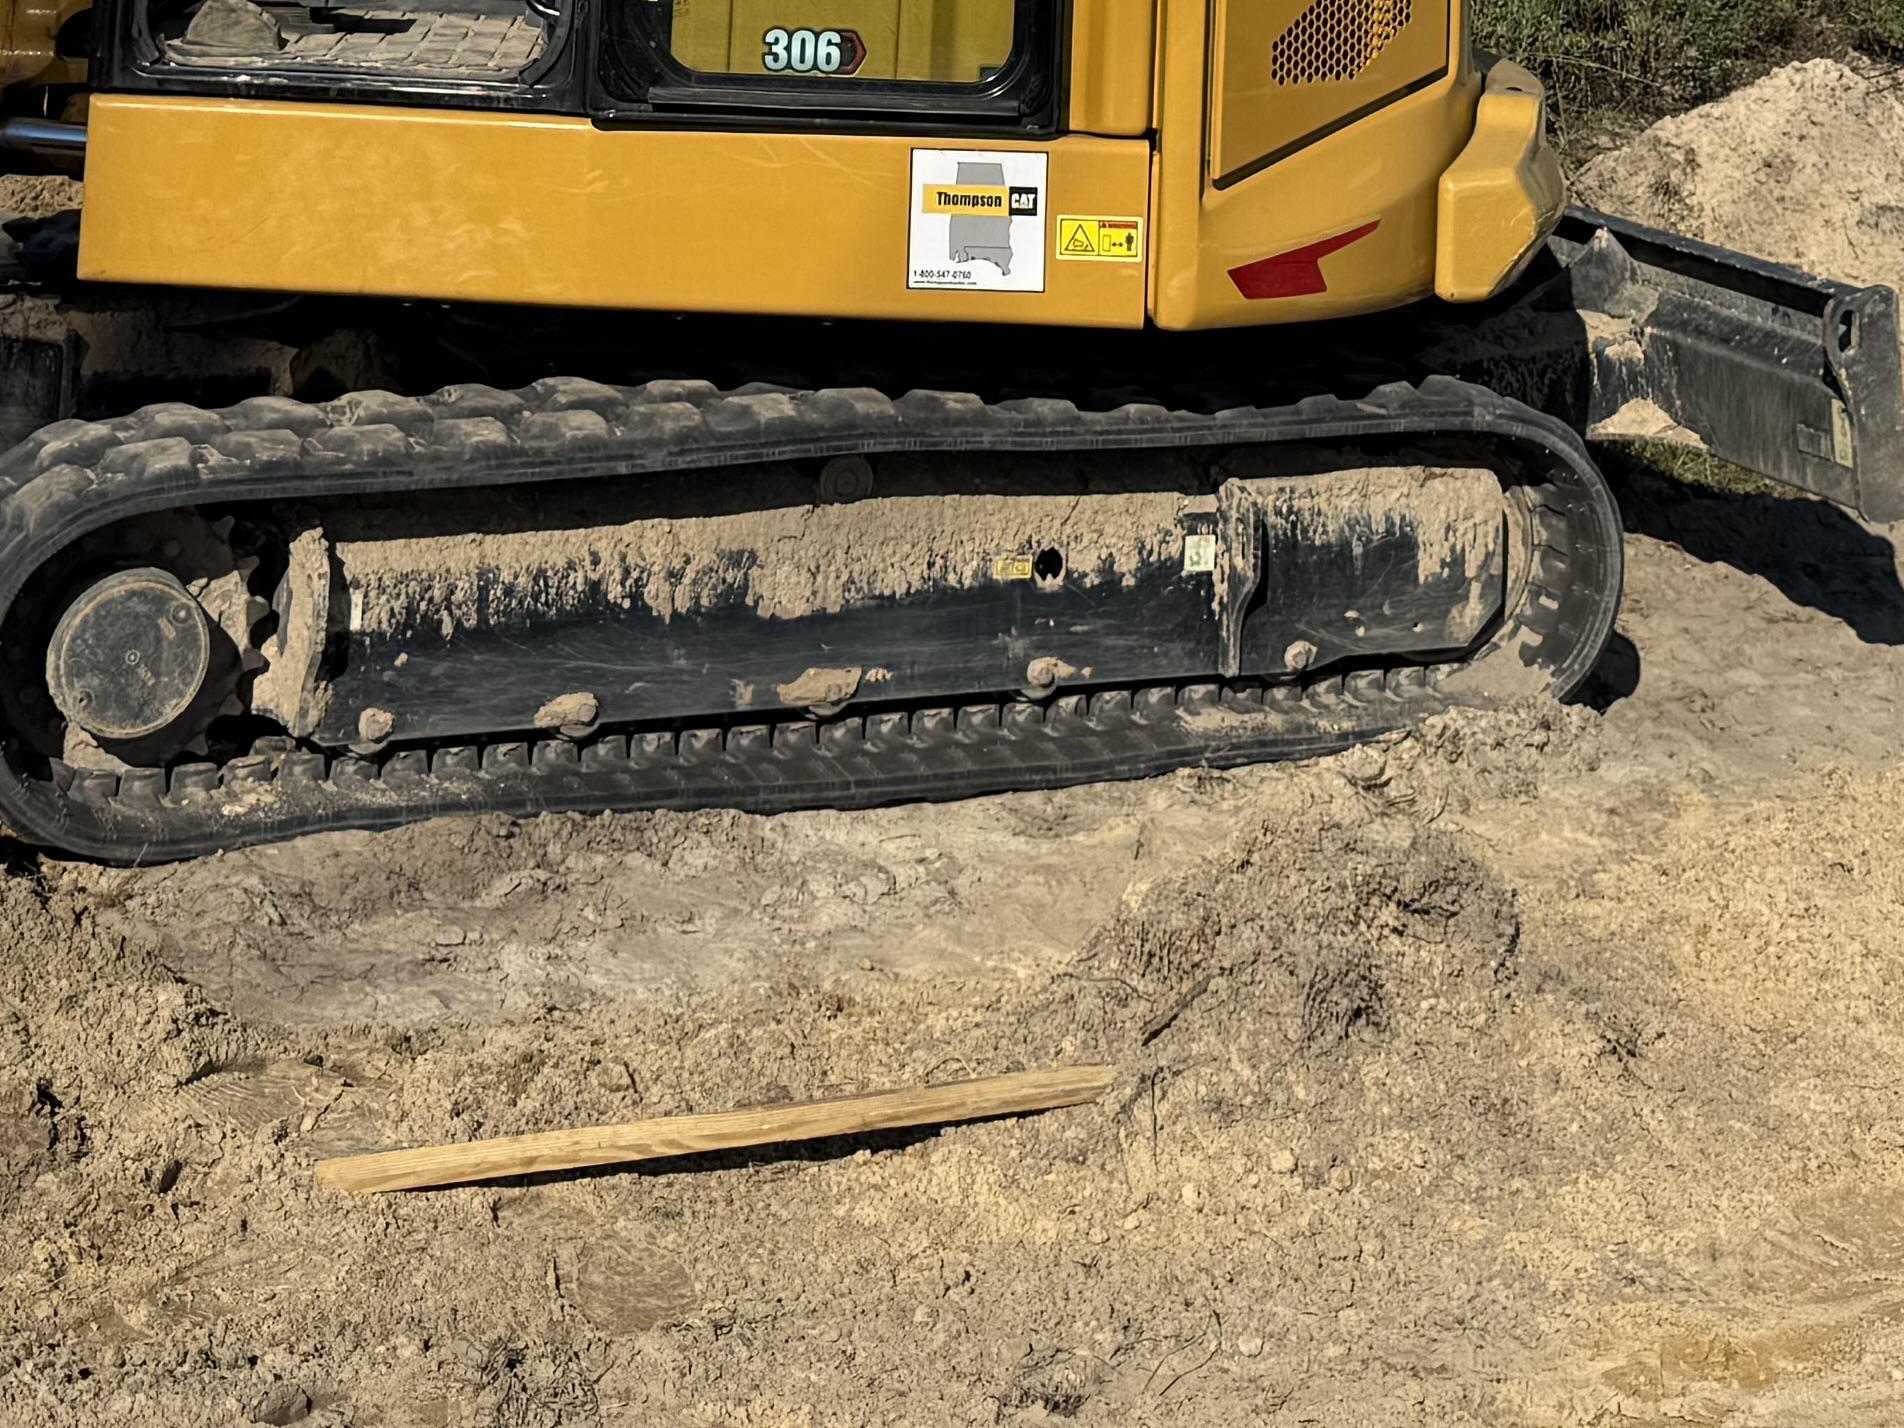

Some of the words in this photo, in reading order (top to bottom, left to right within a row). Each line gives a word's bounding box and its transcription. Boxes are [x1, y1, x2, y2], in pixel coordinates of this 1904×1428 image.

[764, 28, 842, 72] 306
[937, 191, 1002, 207] Thompson
[1011, 193, 1036, 210] CAT
